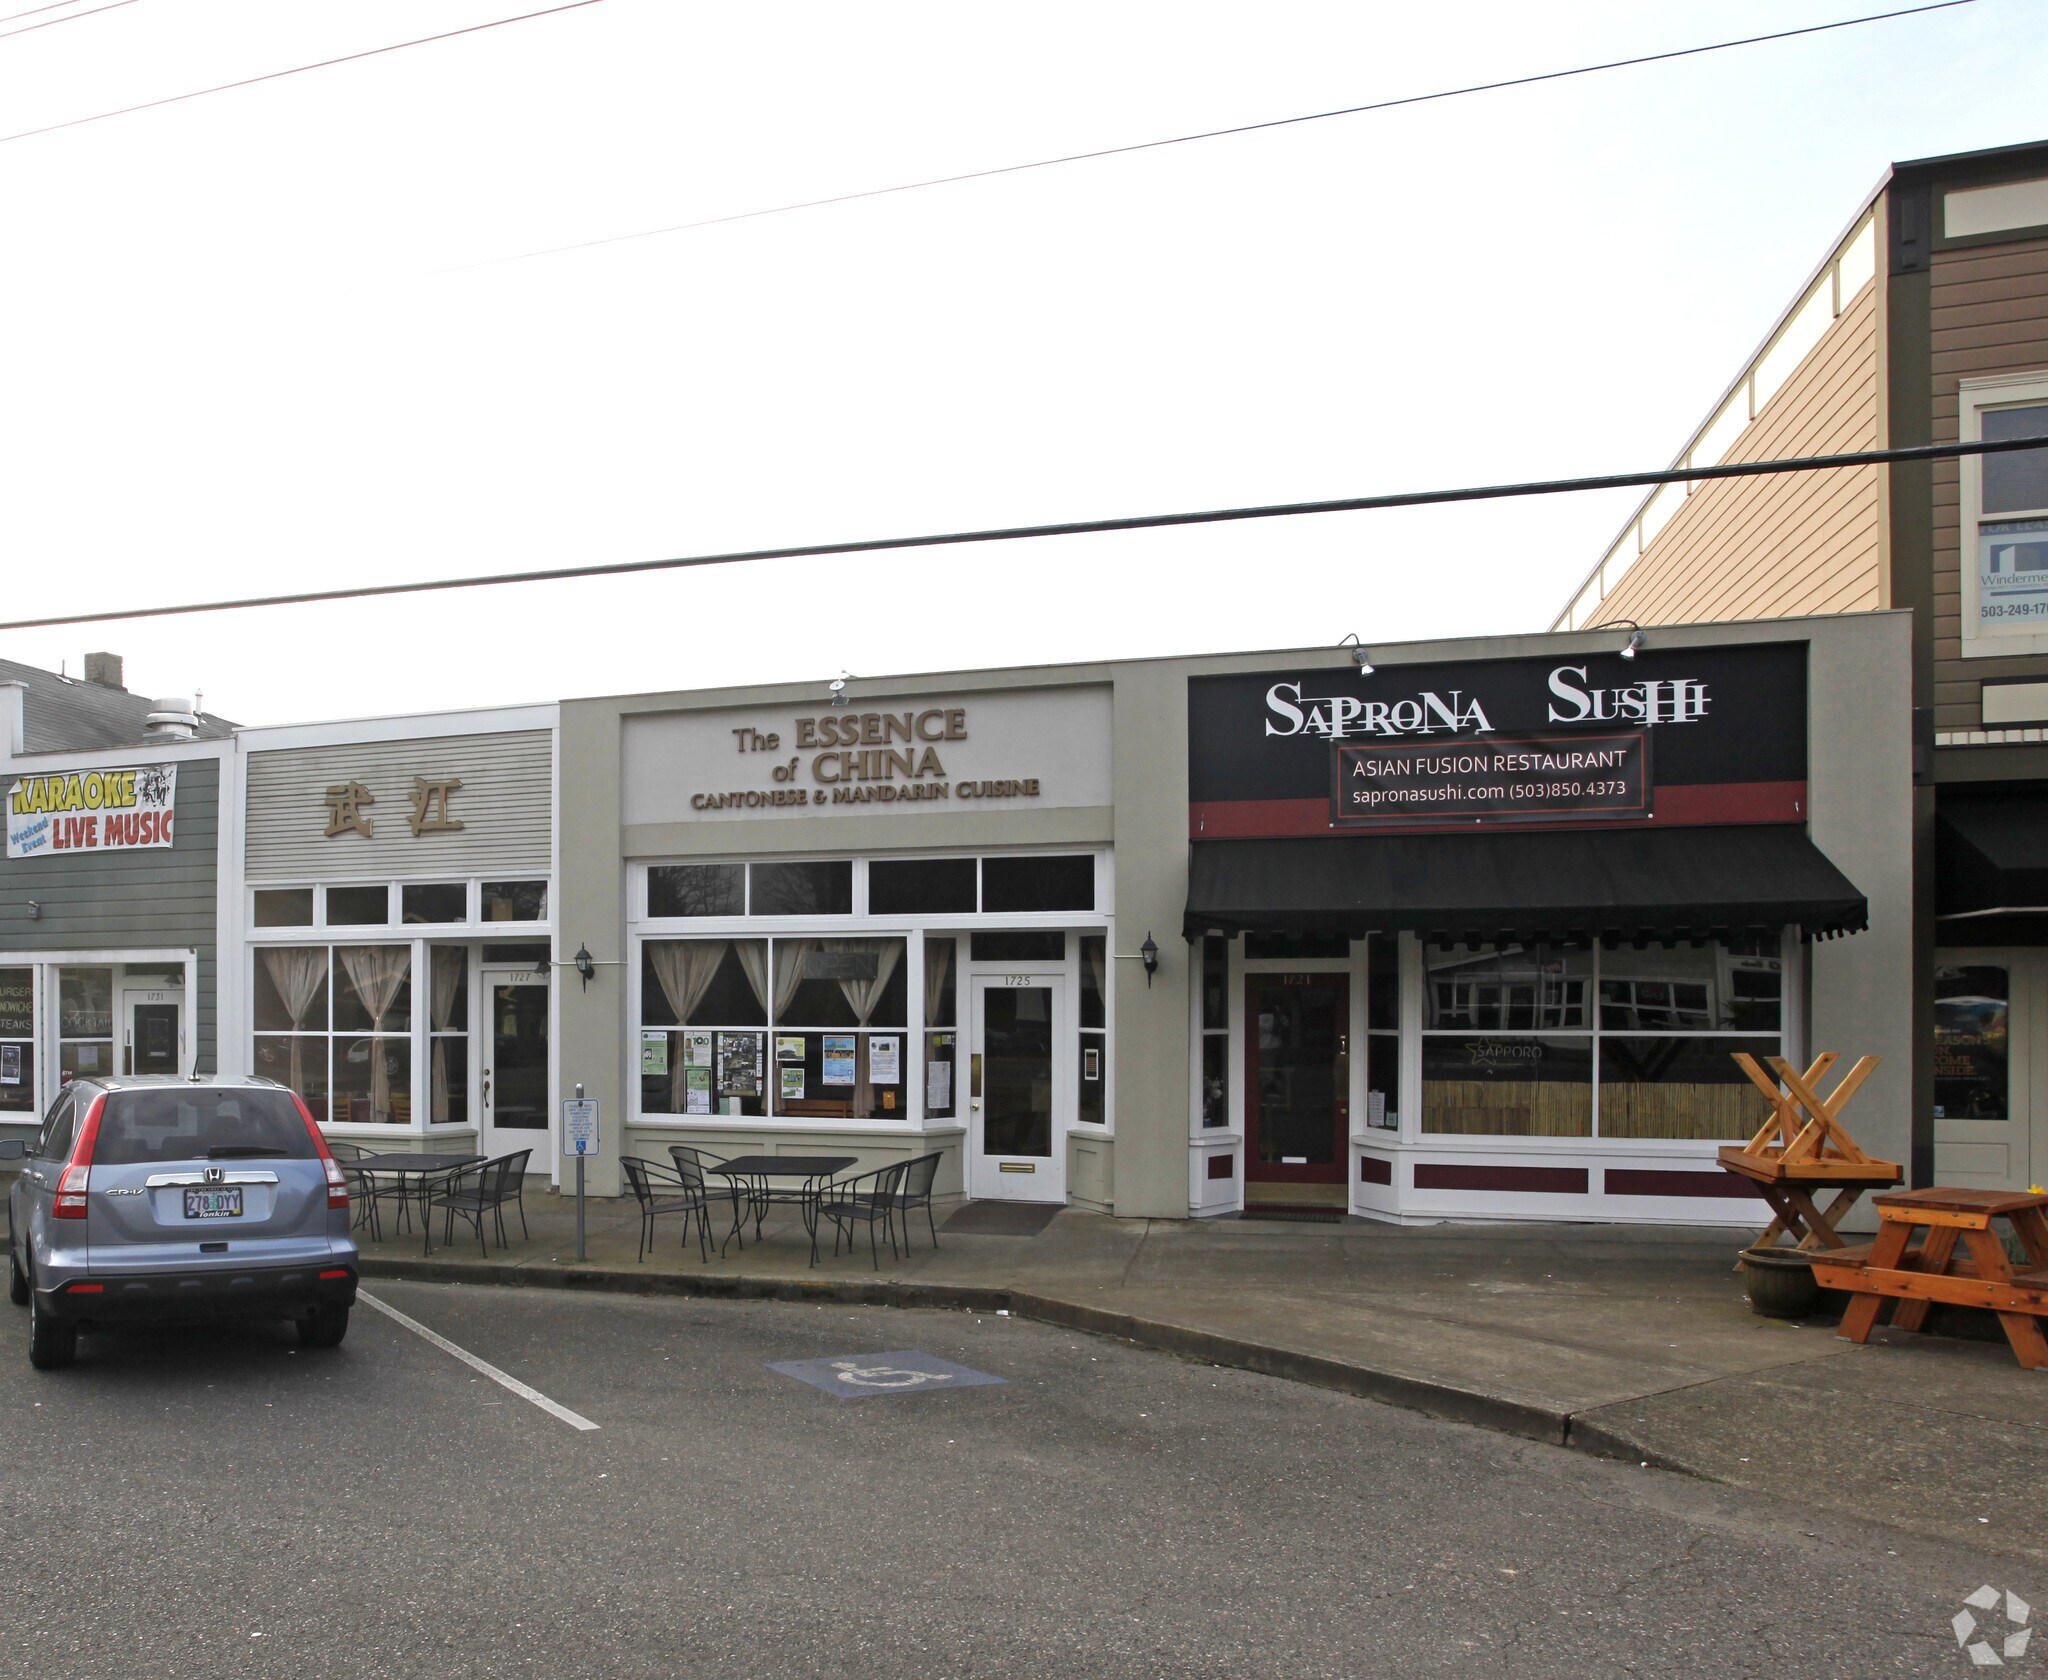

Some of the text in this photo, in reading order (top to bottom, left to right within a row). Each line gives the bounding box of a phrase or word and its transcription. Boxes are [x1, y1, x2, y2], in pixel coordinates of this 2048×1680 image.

[732, 708, 967, 752] The ESSENCE
[772, 746, 945, 783] of CHINA
[1353, 750, 1627, 777] ASIAN FUSION RESTAURANT
[13, 771, 137, 815] KARAOKE
[690, 778, 1040, 810] CANTONESE & MANDARIN CUISINE
[1352, 780, 1626, 807] sapronasushi.com (503)850.4373
[10, 817, 49, 845] Weekend
[53, 809, 174, 849] LIVE MUSIC
[21, 834, 47, 854] Event
[510, 972, 531, 982] 1727
[1005, 976, 1031, 986] 1725
[0, 986, 33, 997] URGER
[147, 993, 164, 1001] 1731
[0, 1018, 32, 1030] TEAKS
[1477, 1045, 1542, 1059] SAPPORO
[187, 1194, 239, 1211] 278 DYY
[199, 1210, 230, 1218] Tonkin
